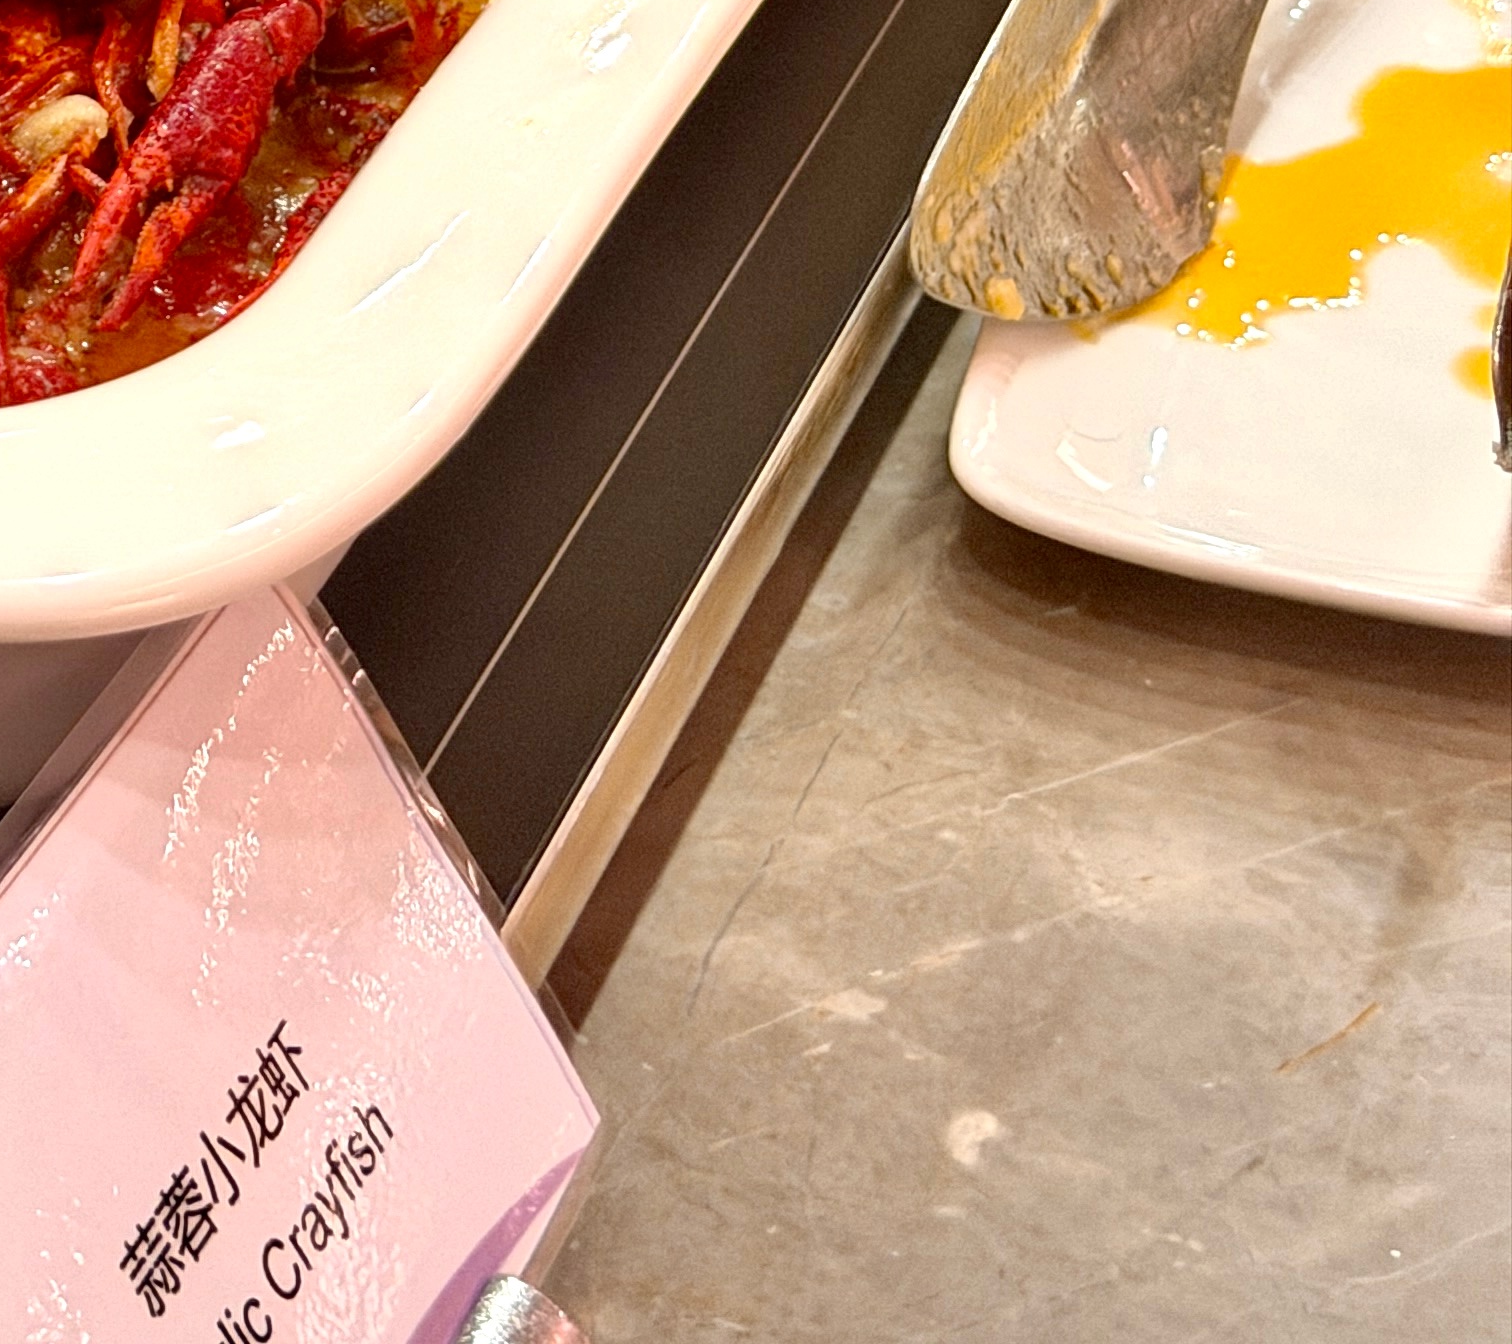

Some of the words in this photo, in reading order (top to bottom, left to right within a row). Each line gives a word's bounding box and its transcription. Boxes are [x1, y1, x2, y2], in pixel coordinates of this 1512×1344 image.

[119, 1018, 311, 1318] 蒜蓉小龙虾
[262, 1104, 394, 1300] Crayfish
